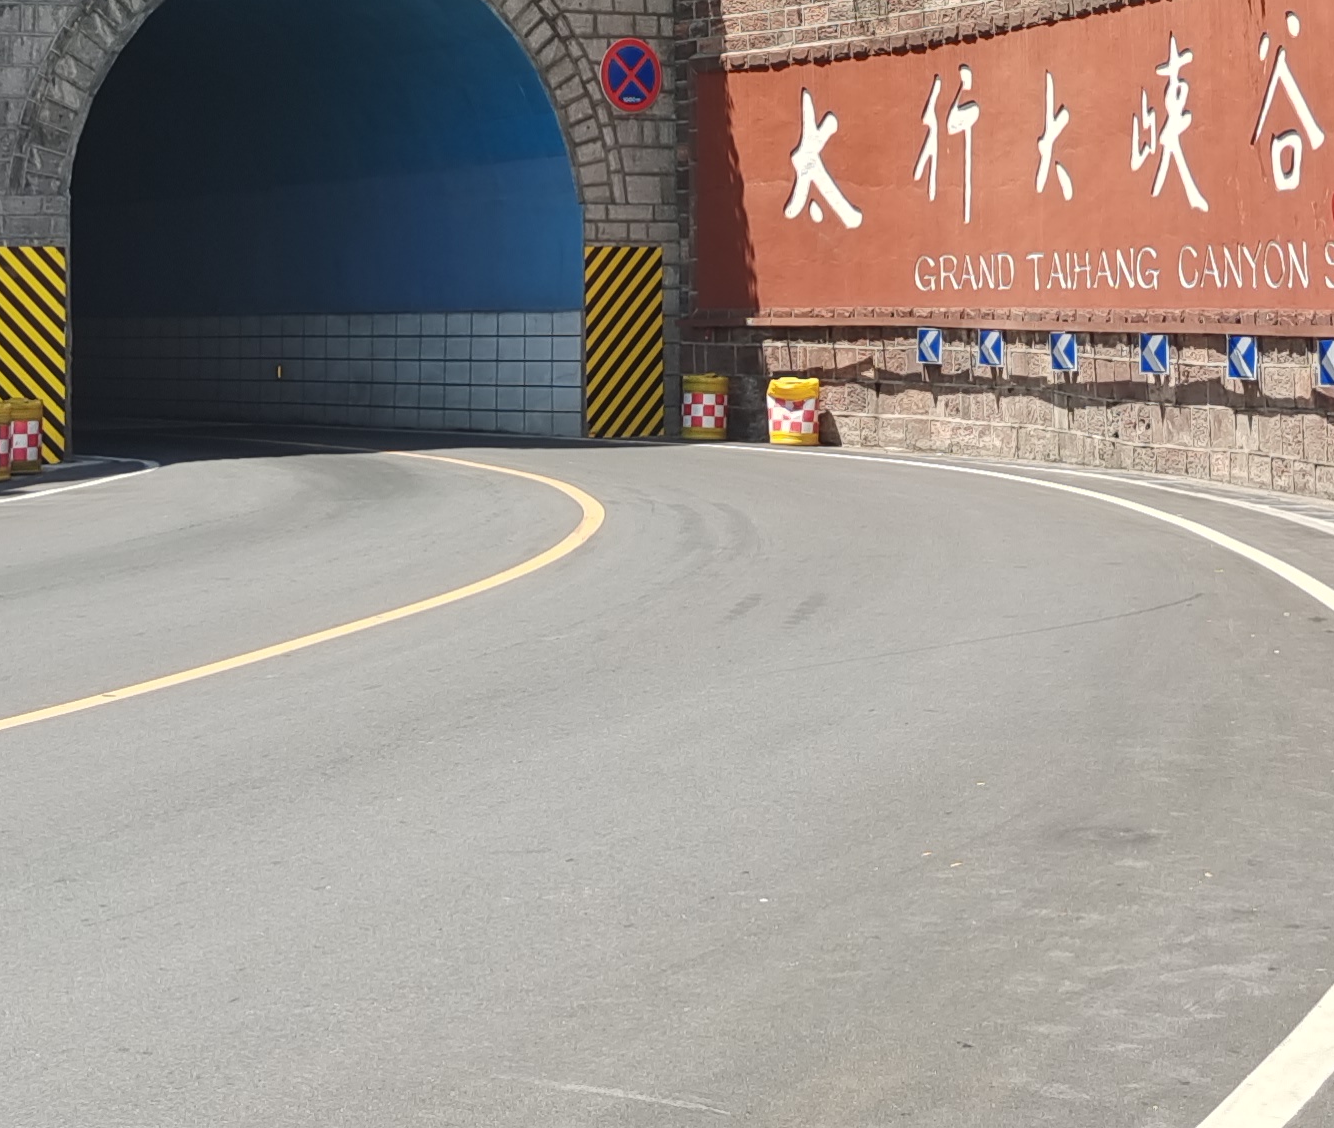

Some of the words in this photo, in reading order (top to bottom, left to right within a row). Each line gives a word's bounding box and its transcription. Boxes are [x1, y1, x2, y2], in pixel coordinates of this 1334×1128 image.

[914, 254, 1015, 291] GRAND
[1026, 246, 1160, 291] TAIHANG
[1177, 241, 1310, 290] CANYON
